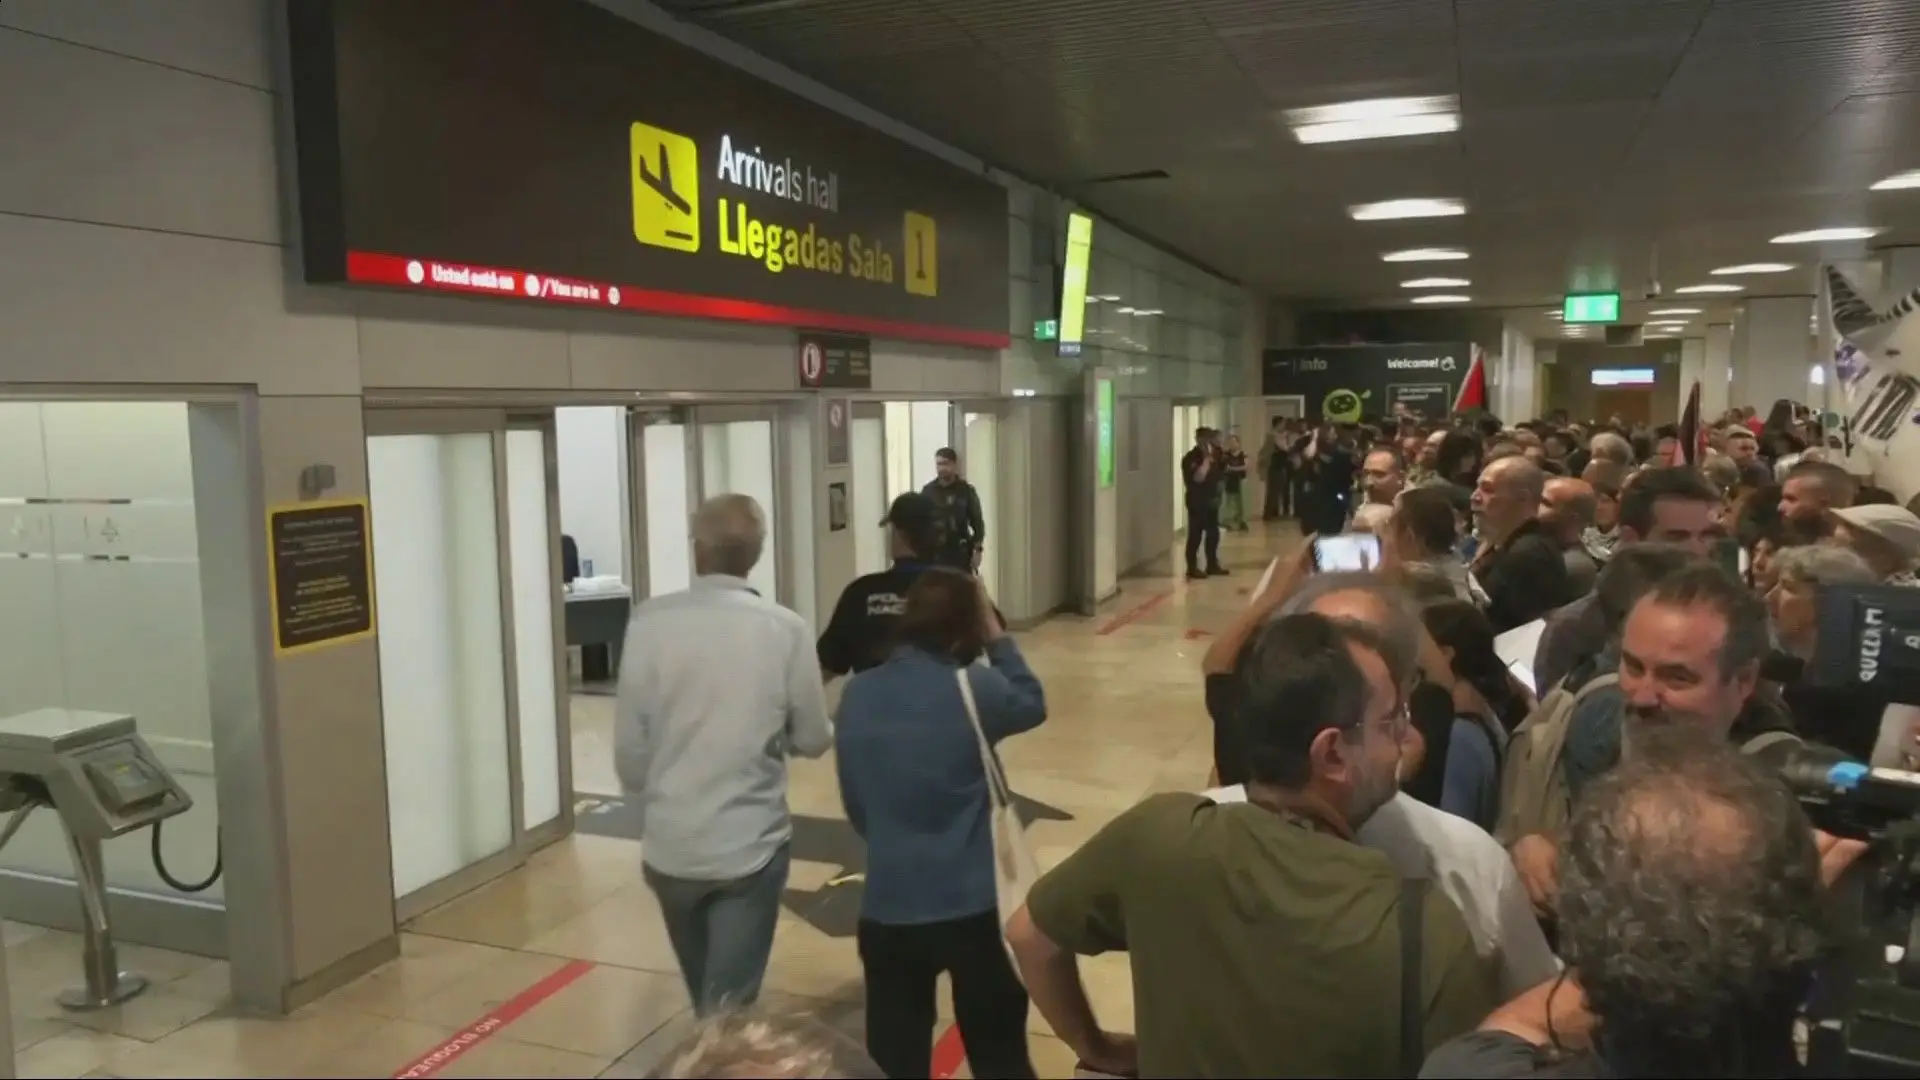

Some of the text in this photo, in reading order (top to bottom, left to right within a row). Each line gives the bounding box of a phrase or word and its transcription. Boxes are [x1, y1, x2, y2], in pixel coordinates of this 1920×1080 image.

[718, 134, 838, 213] Arrivals hall
[719, 198, 844, 273] Llegadas
[848, 232, 894, 284] Sala
[1387, 357, 1439, 369] Welcome!
[867, 604, 908, 616] NAC
